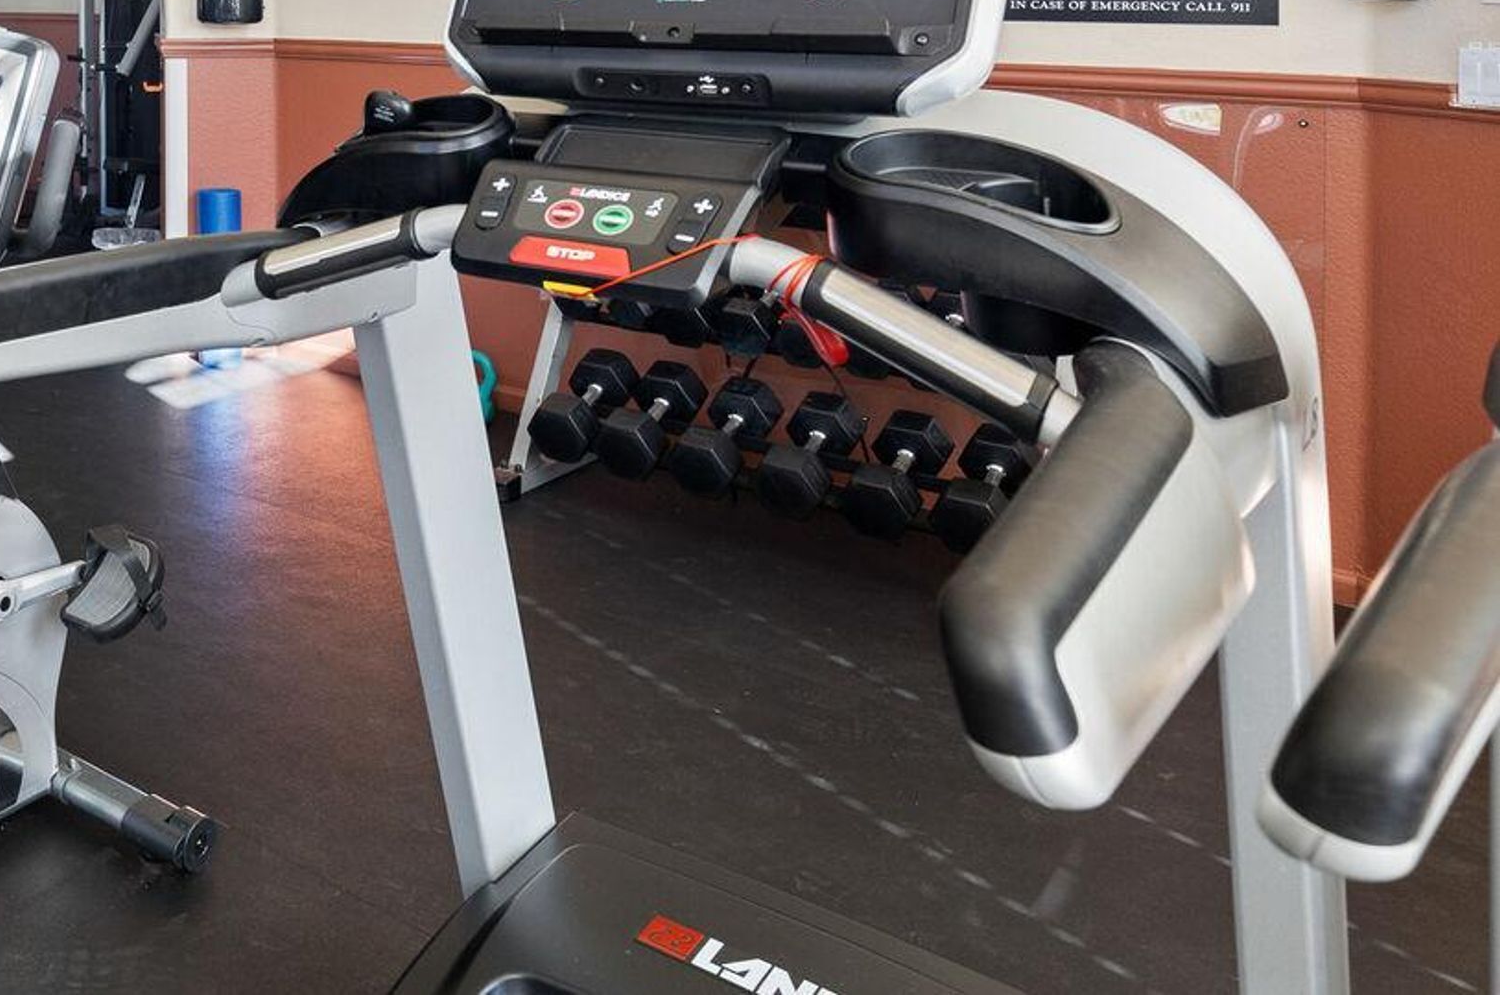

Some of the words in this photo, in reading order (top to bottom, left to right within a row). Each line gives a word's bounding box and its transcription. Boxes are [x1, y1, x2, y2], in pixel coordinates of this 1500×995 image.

[1011, 0, 1026, 9] IN
[1030, 0, 1064, 9] CASE
[1068, 0, 1086, 10] OF
[1092, 0, 1180, 12] EMERGENCY
[1186, 1, 1226, 12] CALL
[1230, 2, 1250, 12] 911
[546, 245, 596, 261] STOP
